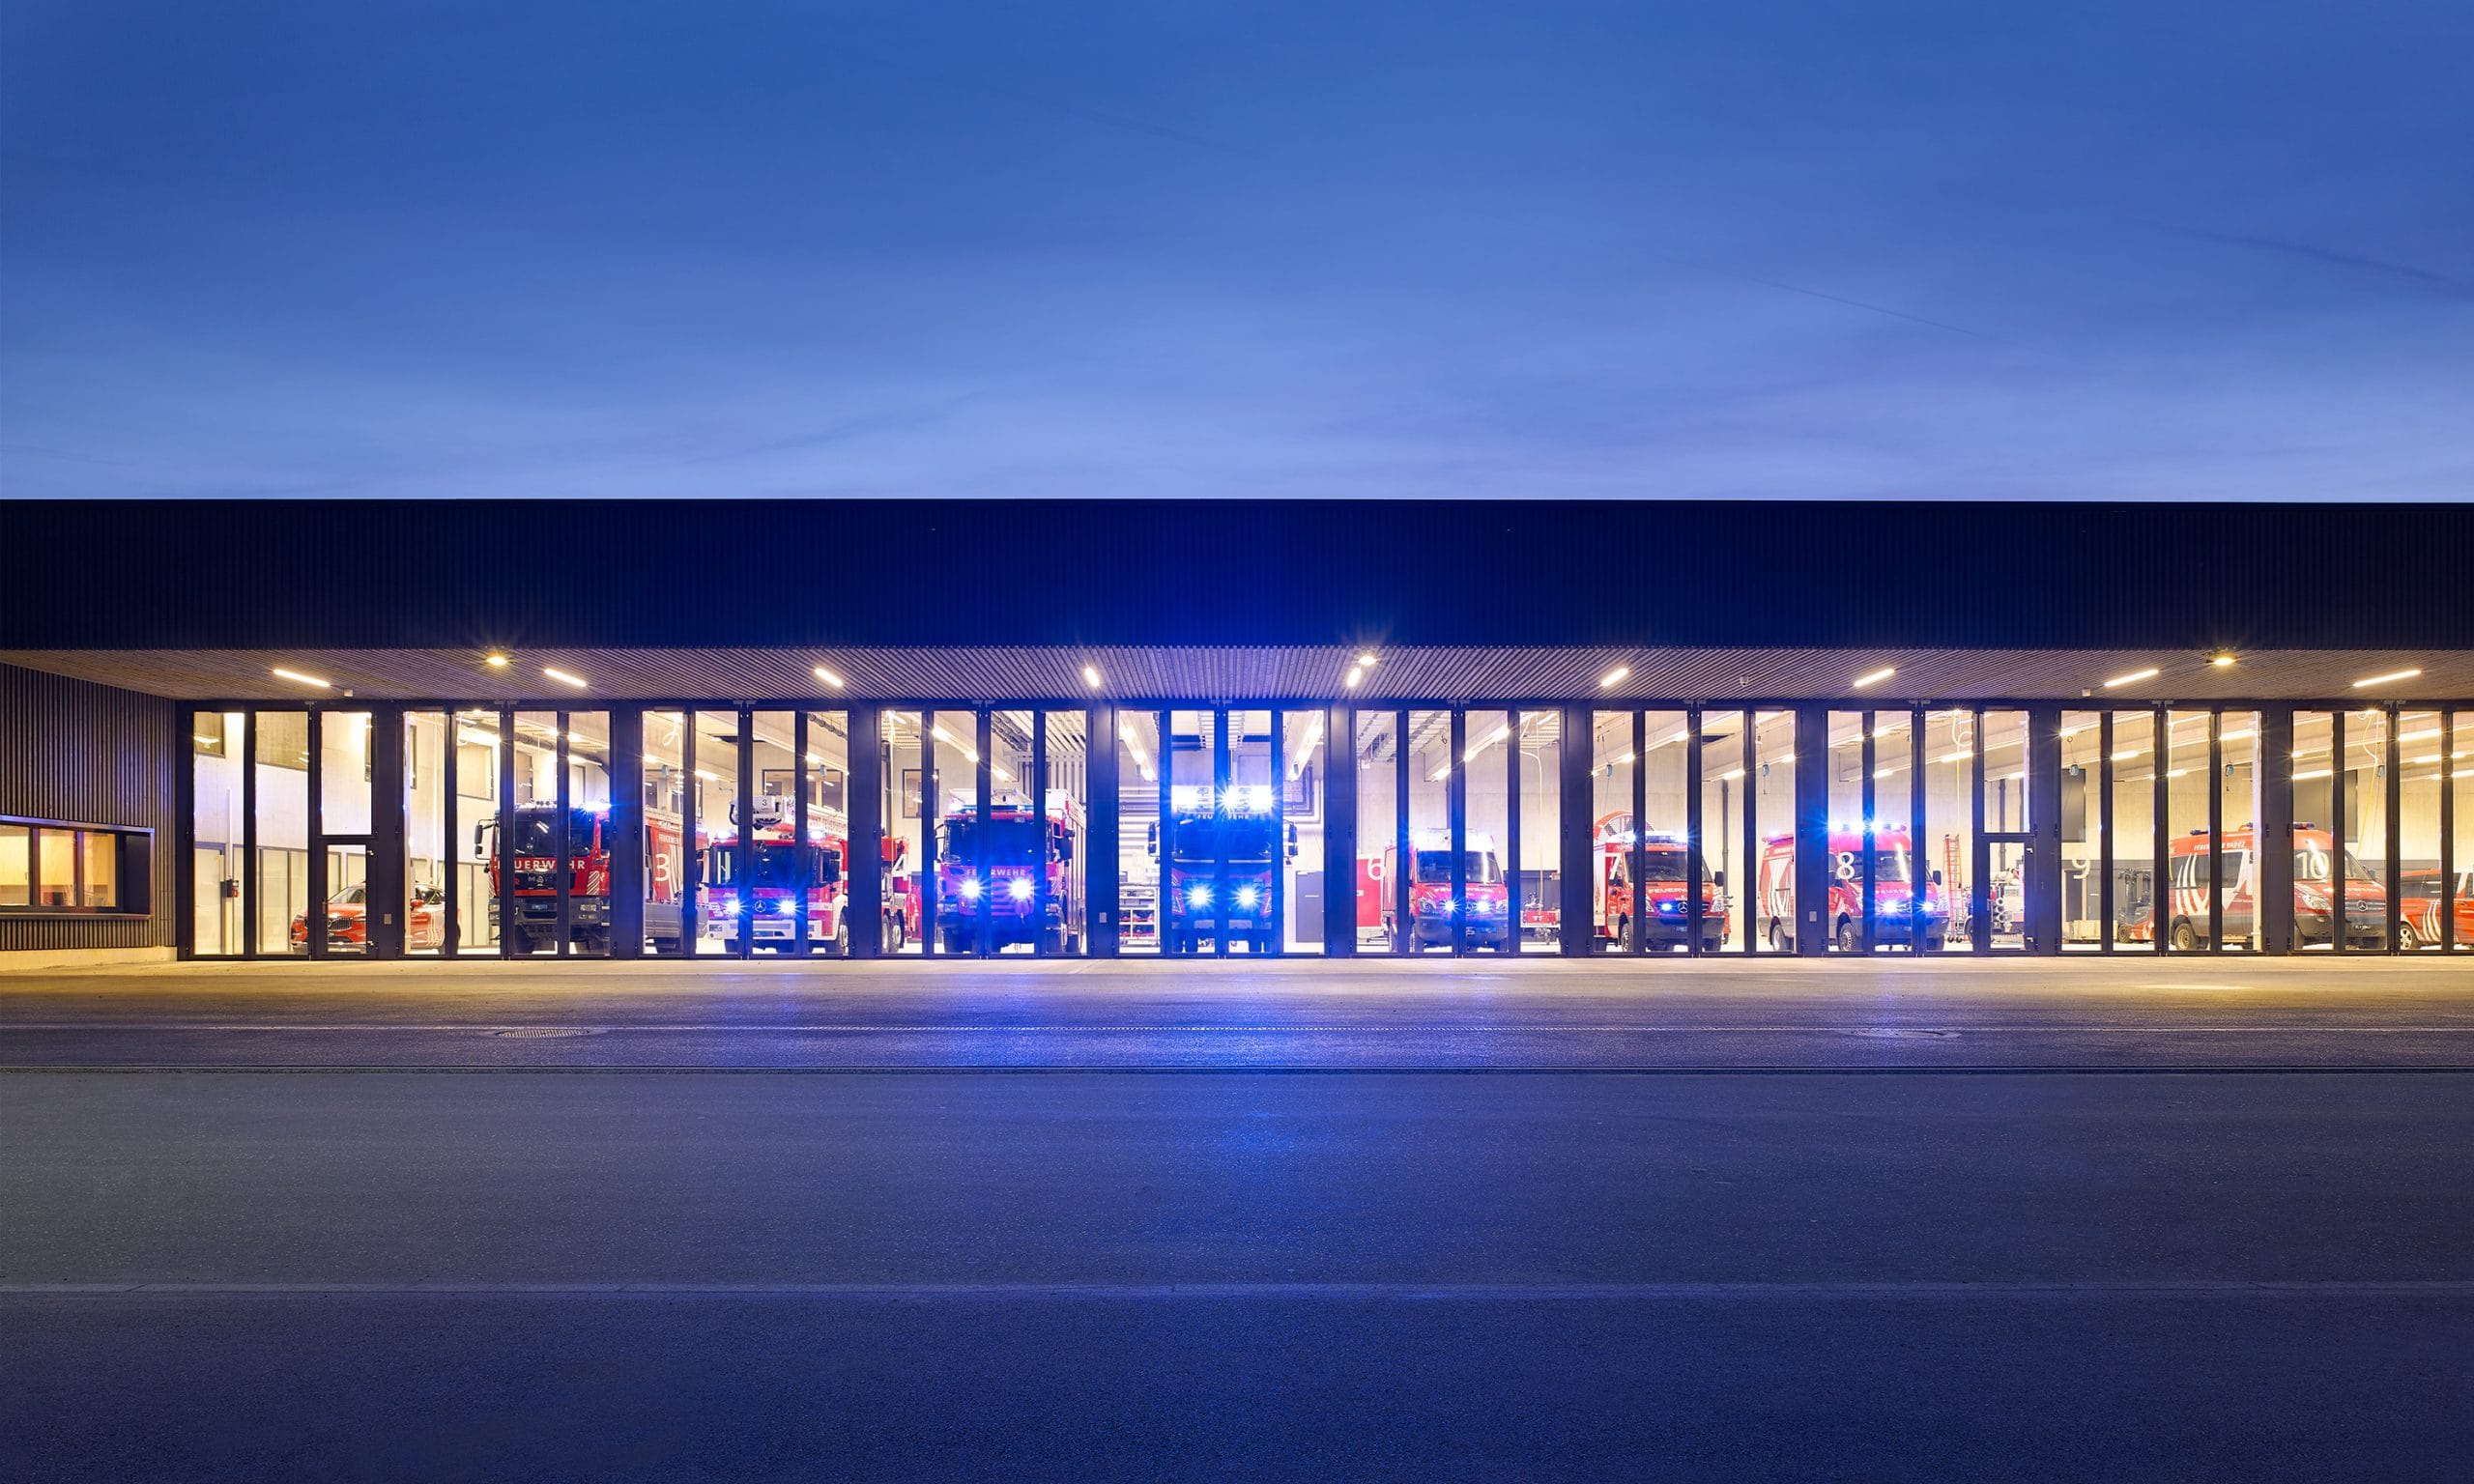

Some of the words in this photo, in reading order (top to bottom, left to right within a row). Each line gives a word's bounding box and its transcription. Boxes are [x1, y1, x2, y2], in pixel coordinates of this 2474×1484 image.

[498, 860, 586, 870] UERWHR
[654, 853, 670, 882] 3
[891, 853, 909, 881] 4
[966, 869, 1025, 877] FERWEHR
[1366, 853, 1386, 881] 6
[1604, 852, 1622, 880] 7
[1836, 851, 1855, 880] 8
[2072, 854, 2090, 879] 9
[2296, 851, 2330, 879] 10
